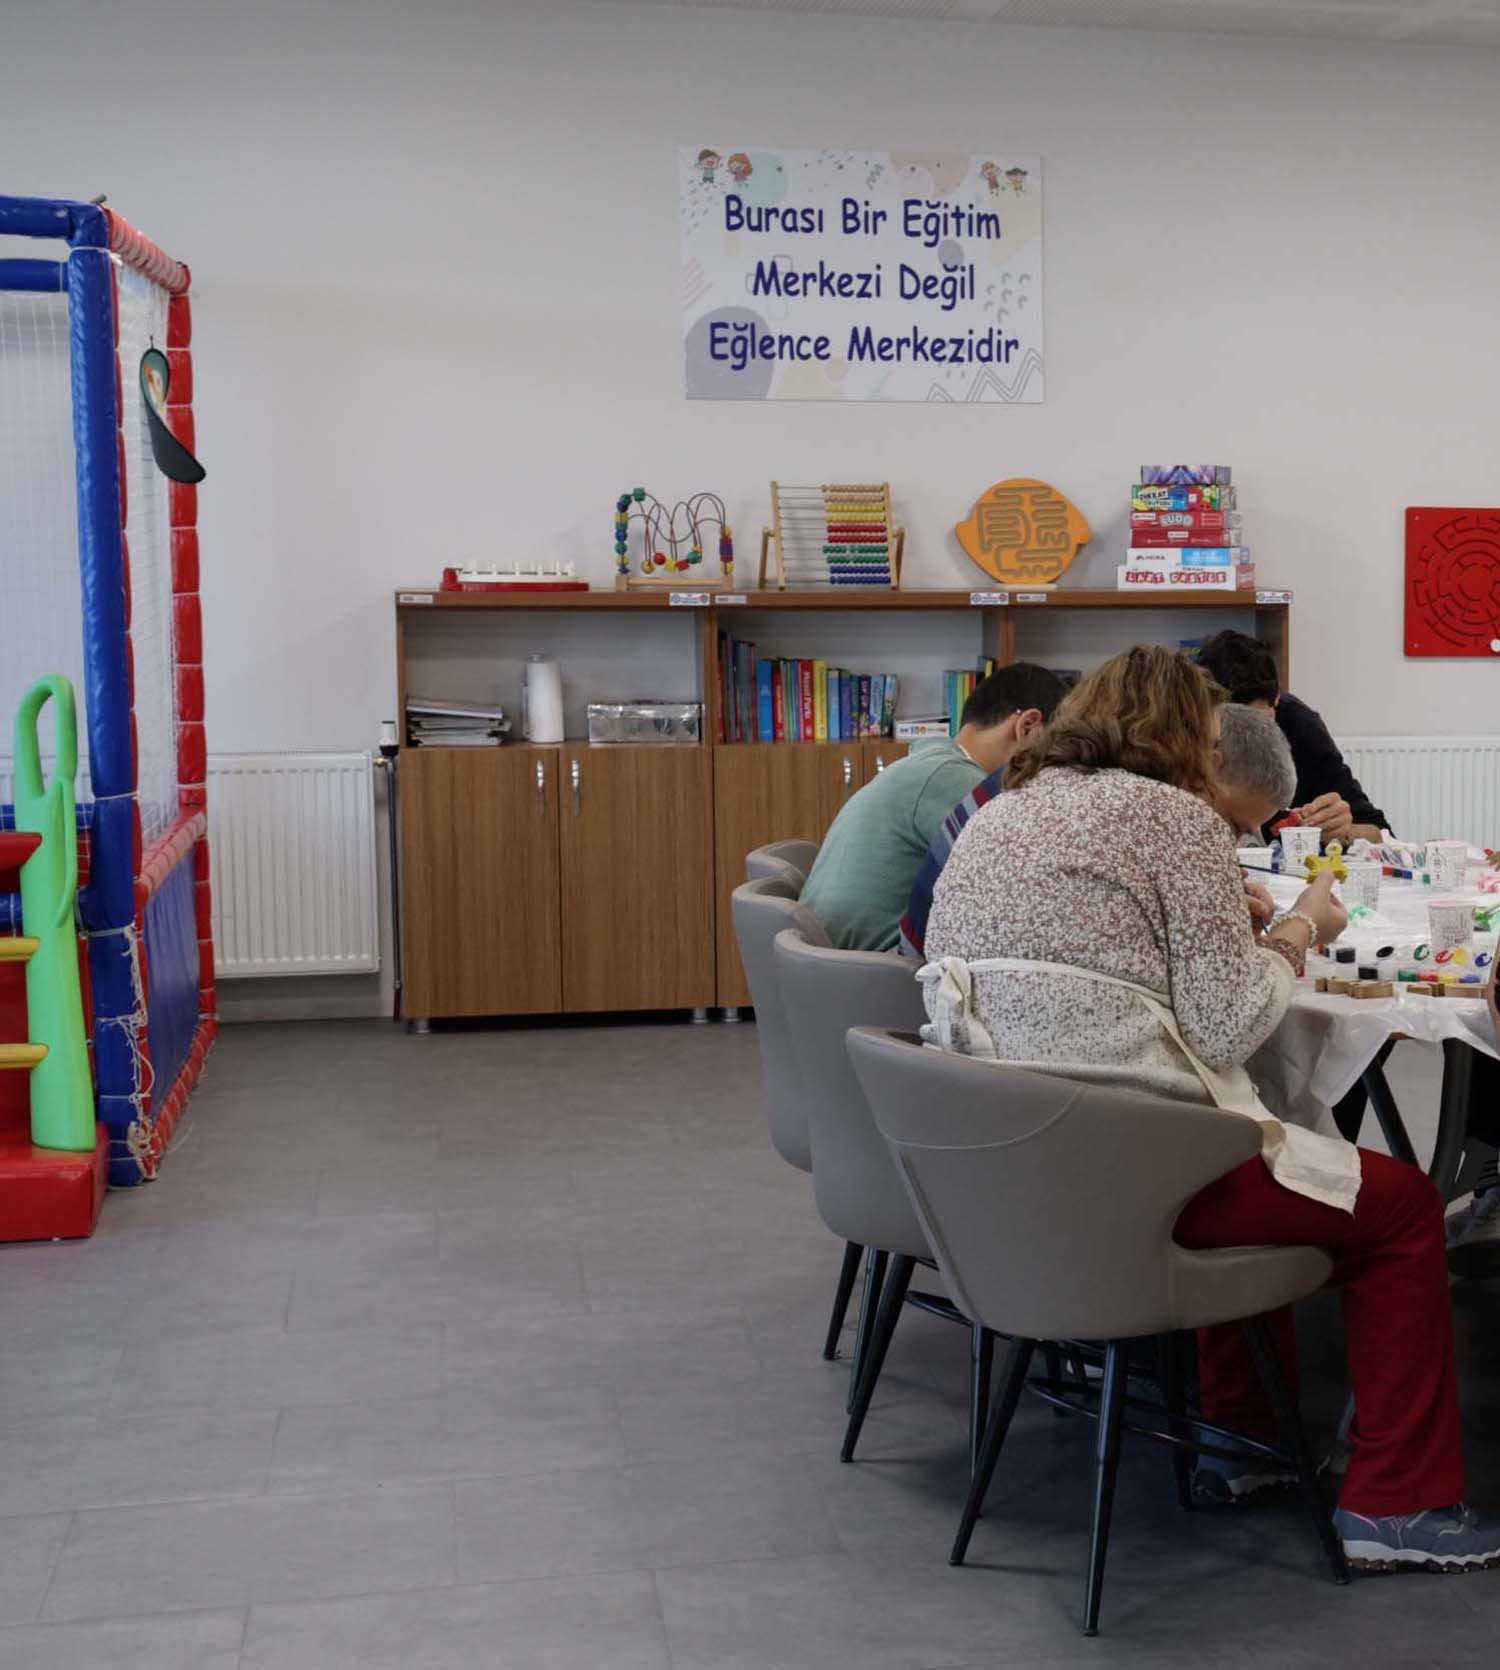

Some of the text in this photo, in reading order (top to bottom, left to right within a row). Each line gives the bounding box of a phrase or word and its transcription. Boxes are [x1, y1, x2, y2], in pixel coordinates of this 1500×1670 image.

[725, 194, 1001, 248] Burası Bir Eğitim
[752, 260, 975, 311] Merkezi Değil
[709, 321, 1019, 371] Eğlence Merkezidir
